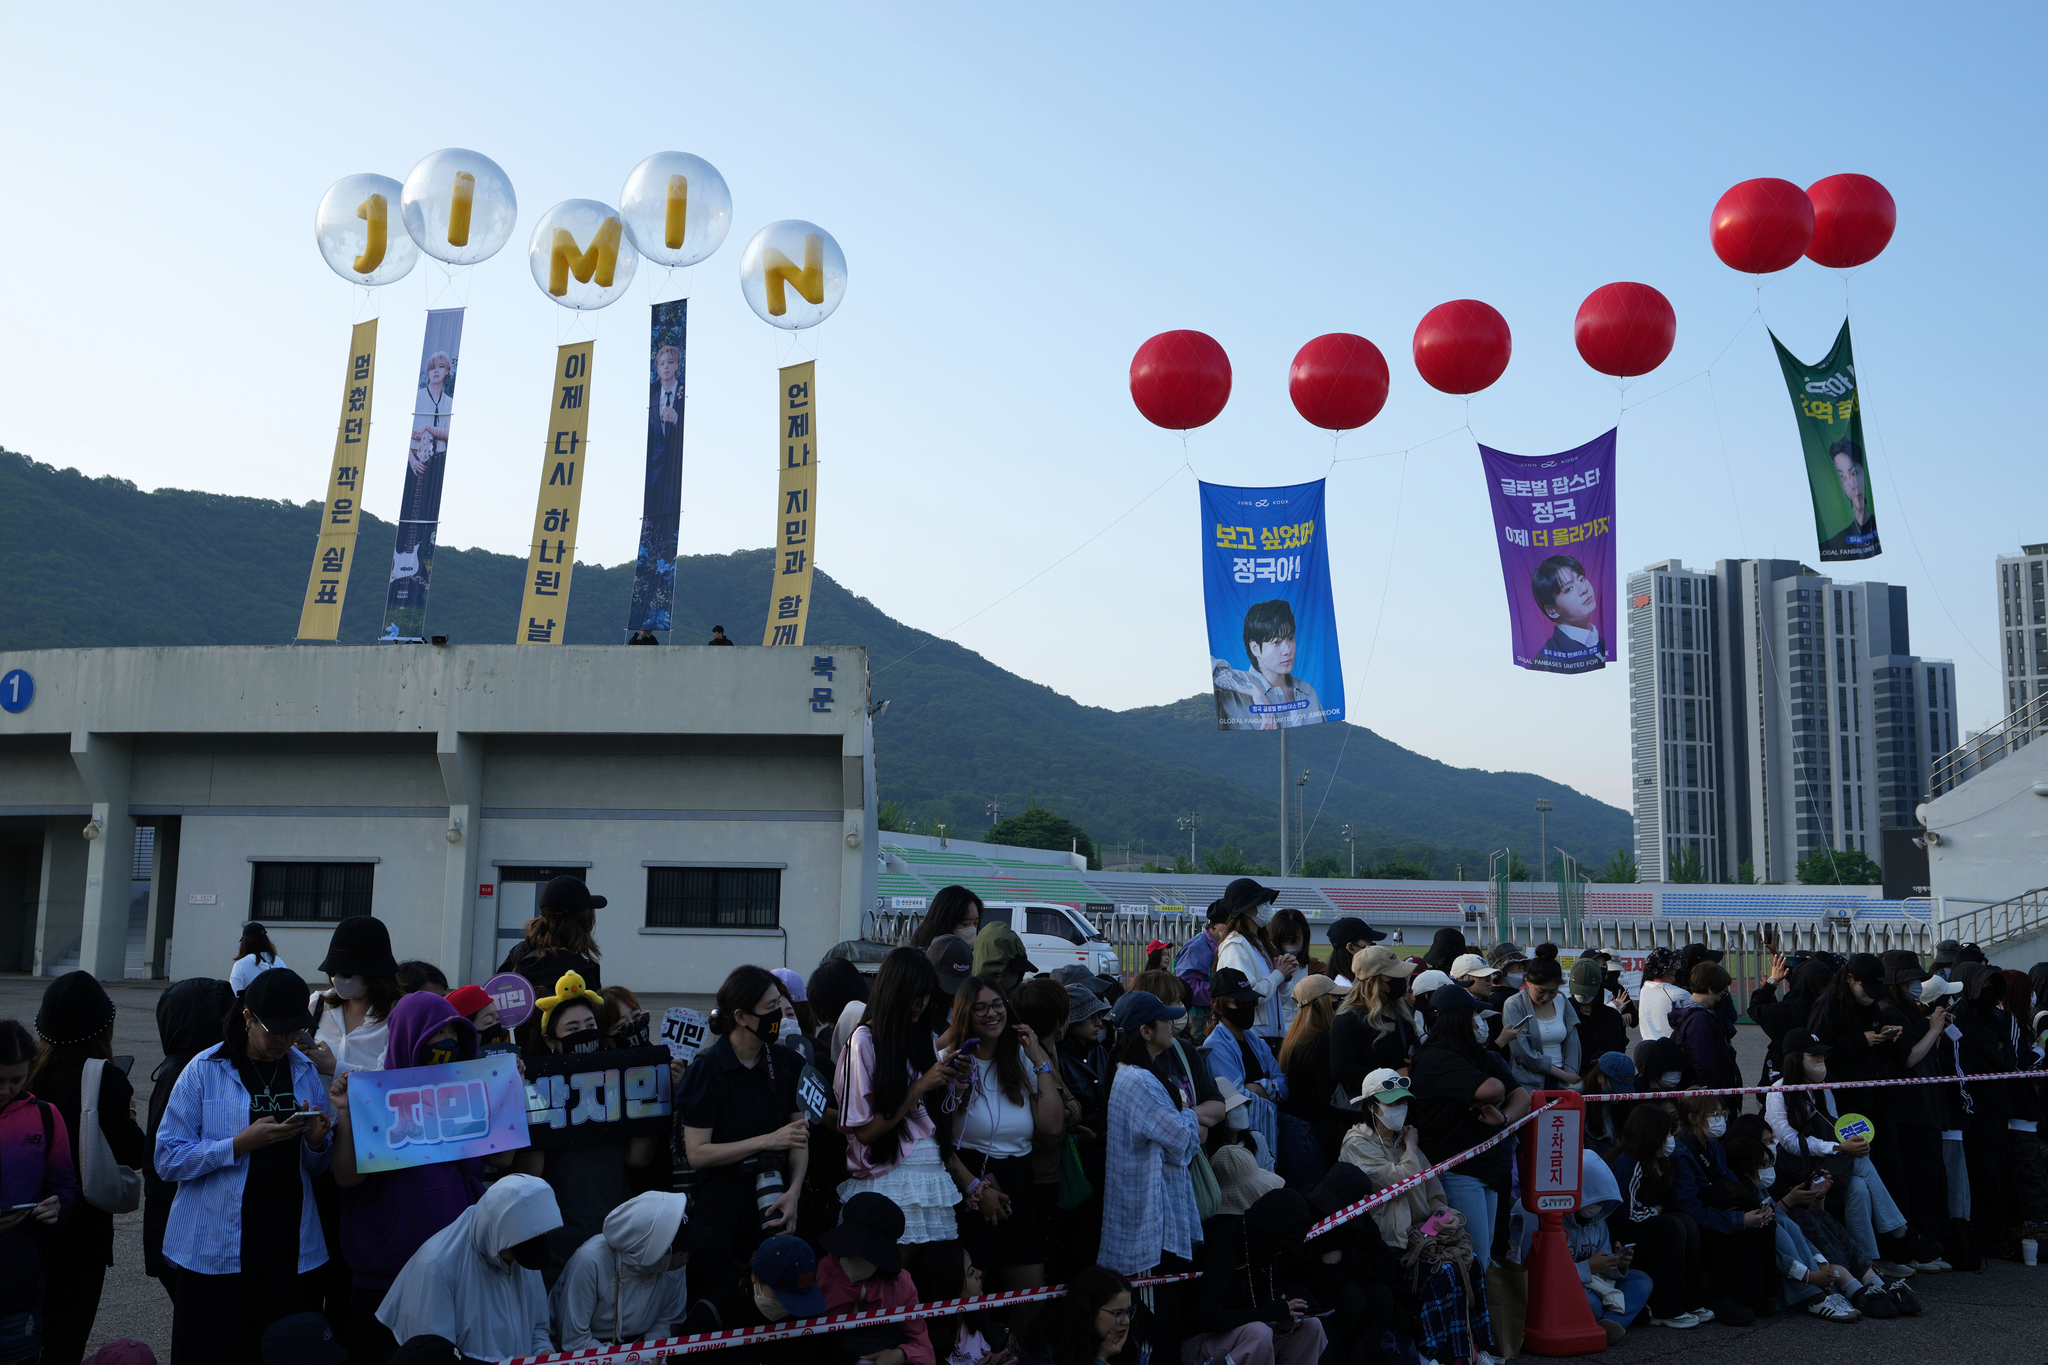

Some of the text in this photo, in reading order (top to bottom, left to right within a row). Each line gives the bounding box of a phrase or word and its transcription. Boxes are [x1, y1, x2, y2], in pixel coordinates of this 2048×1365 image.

[313, 353, 372, 605] 멈췄던 작은 쉼표
[1500, 467, 1601, 497] 글로벌 팝스타
[526, 353, 588, 644] 이제 다시 하나된 날
[771, 381, 813, 646] 언제나 지민과 함께
[1531, 498, 1577, 524] 정국
[1216, 523, 1257, 550] 보고
[1505, 526, 1530, 547] 이제
[1532, 530, 1549, 547] 더
[1233, 555, 1301, 584] 정국아!
[1534, 659, 1562, 668] FANBASES
[1563, 661, 1585, 669] UNITED
[1586, 658, 1599, 667] FOR
[9, 674, 20, 703] 1
[809, 656, 836, 713] 북문
[1273, 716, 1294, 724] UNITED
[1308, 708, 1341, 719] JUNGKOOK
[491, 989, 527, 1011] 지민
[661, 1018, 706, 1049] 지민
[798, 1076, 829, 1119] 지민
[384, 1078, 491, 1151] 지민
[1549, 1115, 1565, 1186] 주차금지
